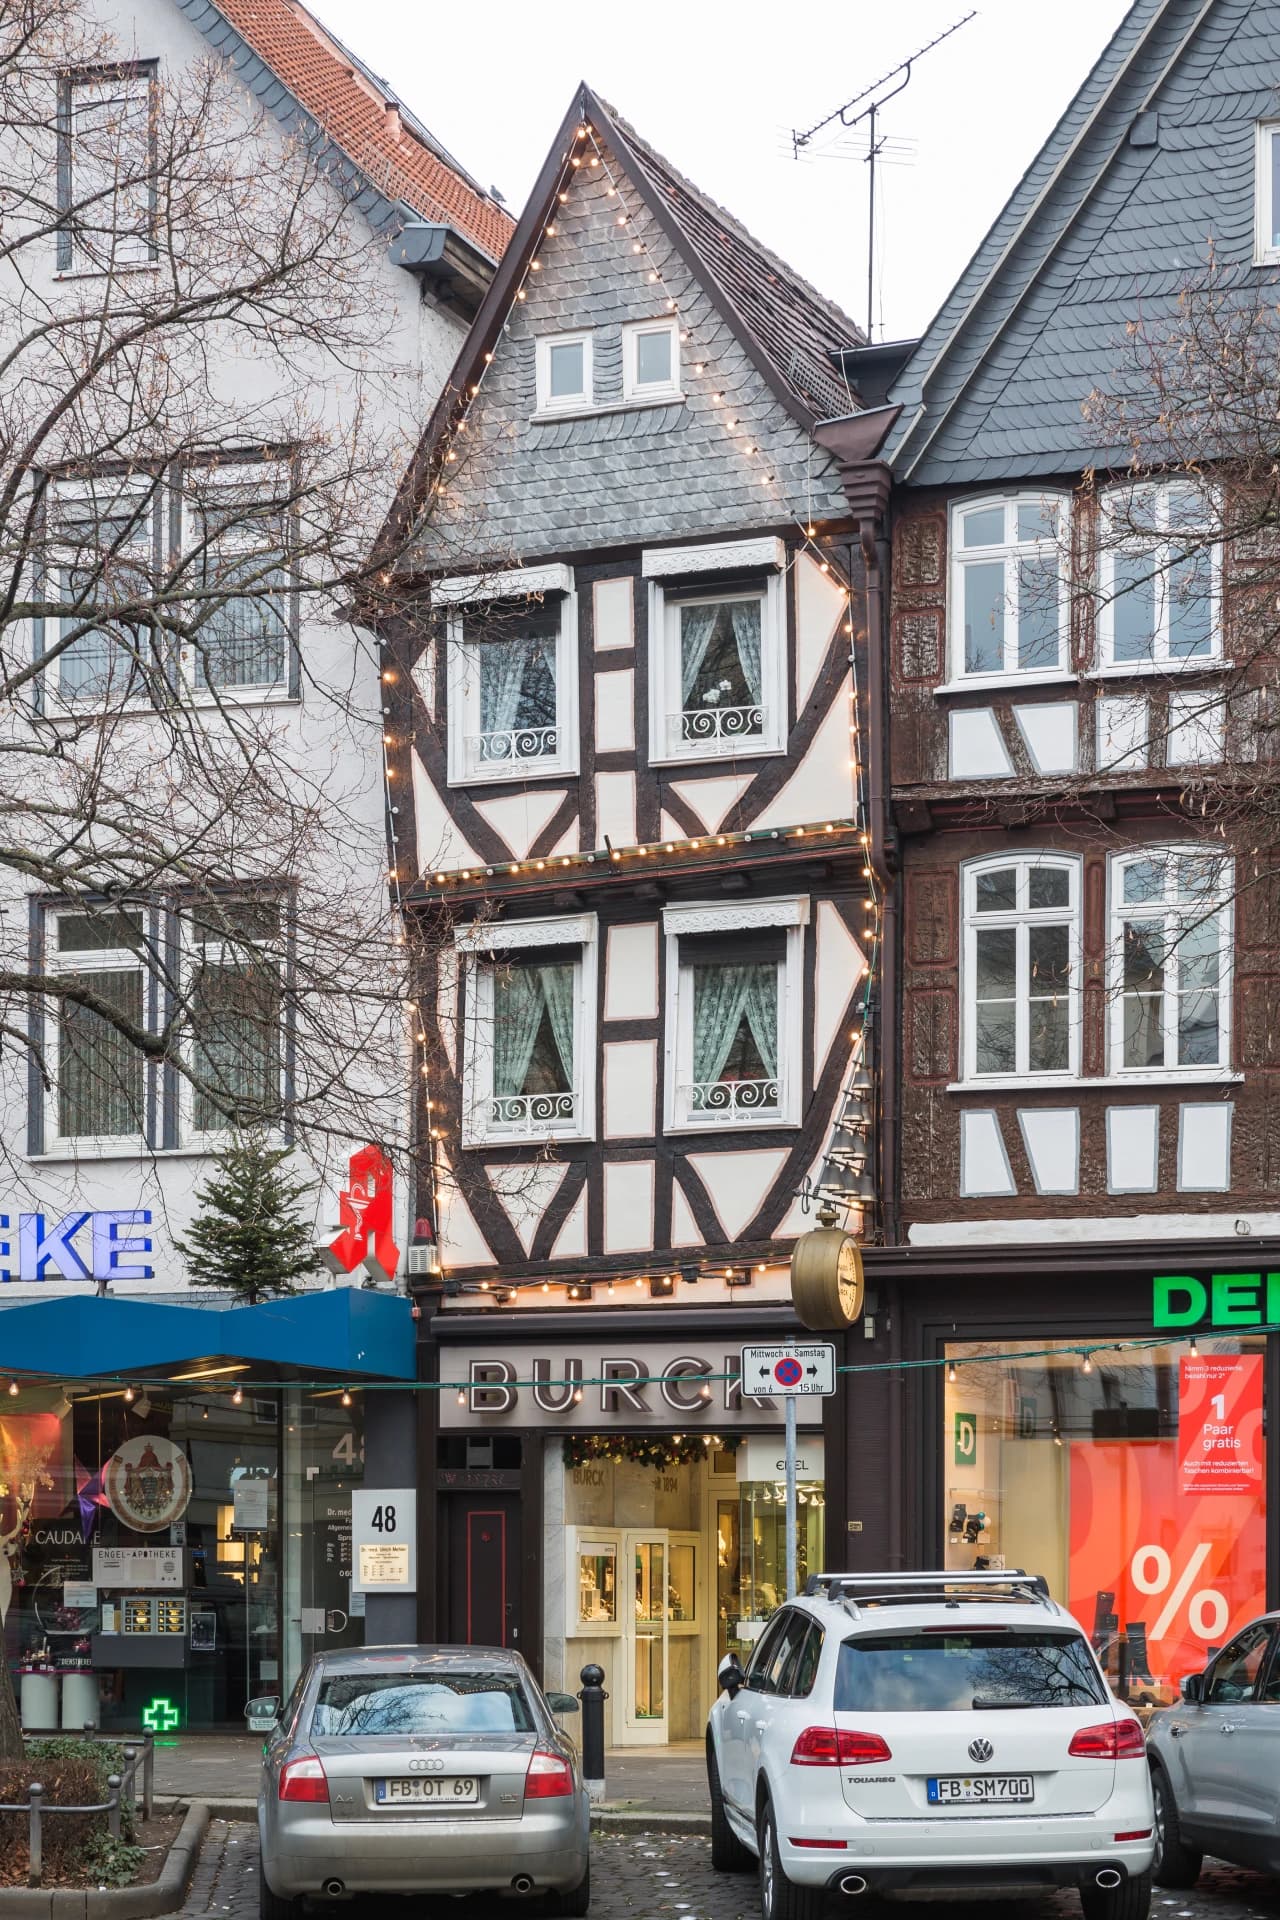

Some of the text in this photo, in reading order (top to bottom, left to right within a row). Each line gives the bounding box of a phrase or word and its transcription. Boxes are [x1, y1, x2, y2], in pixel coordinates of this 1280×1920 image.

[751, 1350, 784, 1358] Mittwoch
[794, 1348, 826, 1359] Samstag
[768, 1384, 773, 1393] 6
[799, 1383, 810, 1392] 15
[811, 1383, 824, 1392] Uhr
[1210, 1393, 1225, 1420] 1
[1203, 1424, 1233, 1435] Paar
[959, 1421, 974, 1456] D
[1202, 1438, 1241, 1451] gratis
[332, 1432, 365, 1466] 4
[776, 1460, 809, 1471] EEL
[573, 1468, 605, 1486] BURCK
[663, 1476, 678, 1493] 1894
[371, 1505, 397, 1533] 48
[98, 1550, 177, 1559] ENGEL-APOTHEKE
[390, 1780, 412, 1797] FB
[423, 1780, 445, 1796] OT
[453, 1779, 474, 1796] 69
[847, 1776, 896, 1784] TOUAREG
[939, 1781, 962, 1798] FB
